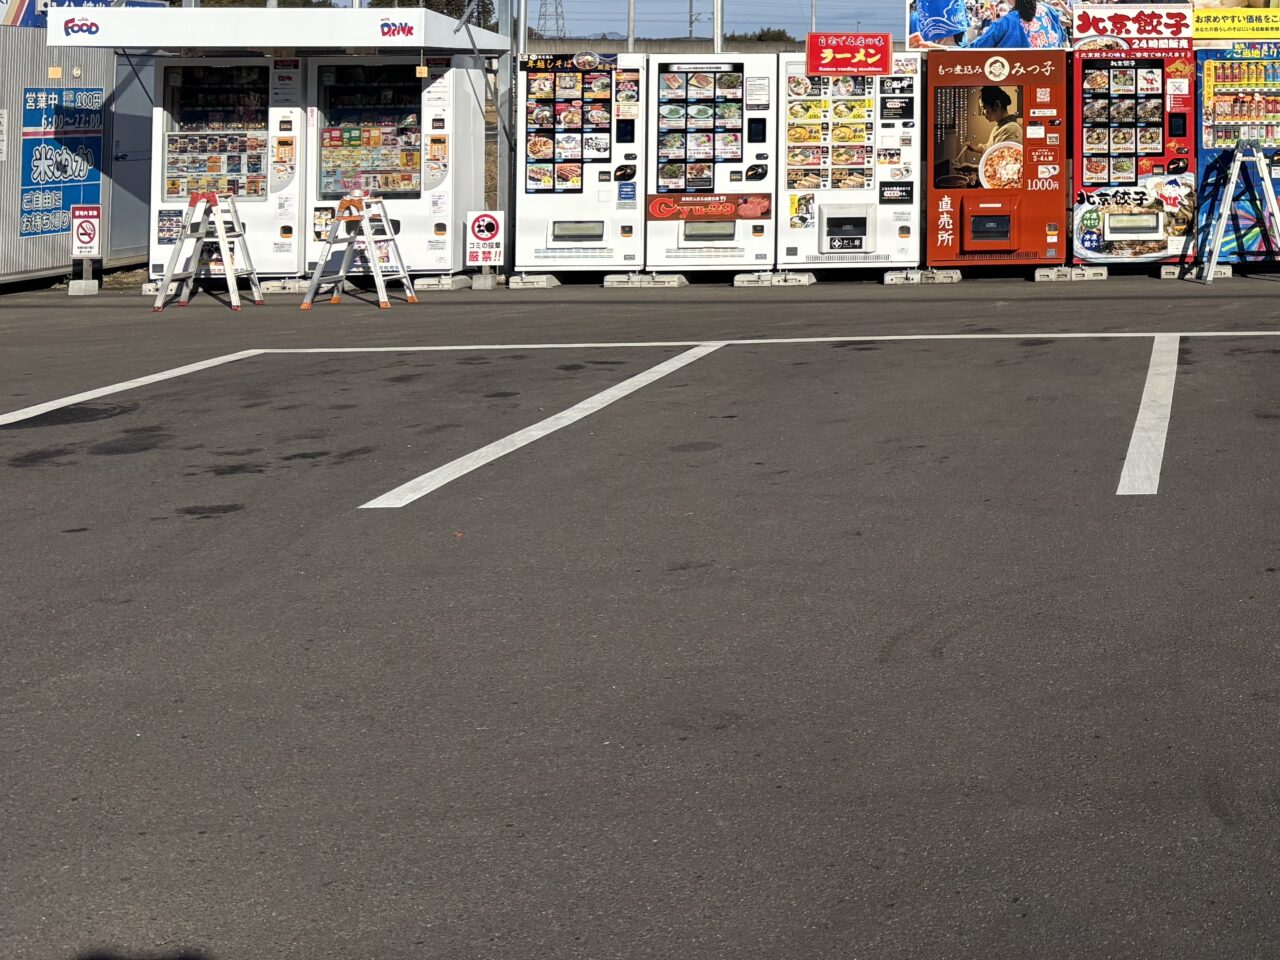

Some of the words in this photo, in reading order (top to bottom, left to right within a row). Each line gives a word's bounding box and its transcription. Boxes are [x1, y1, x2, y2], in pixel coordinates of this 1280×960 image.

[63, 17, 100, 37] FOOD
[380, 22, 414, 37] DRINK
[1076, 10, 1190, 37] 北京餃子
[1131, 39, 1189, 49] 24時間販売
[820, 48, 881, 64] ラーメン
[937, 65, 983, 76] もつ煮込み
[1011, 61, 1056, 77] みつ子
[25, 91, 59, 110] 営業中
[75, 91, 103, 110] 100円
[32, 144, 94, 183] 米ぬか
[22, 190, 62, 211] ご自由に
[1076, 189, 1149, 206] 北京餃子
[21, 210, 71, 233] お持ち帰り
[937, 194, 954, 247] 直売所
[468, 251, 502, 262] 厳禁!!
